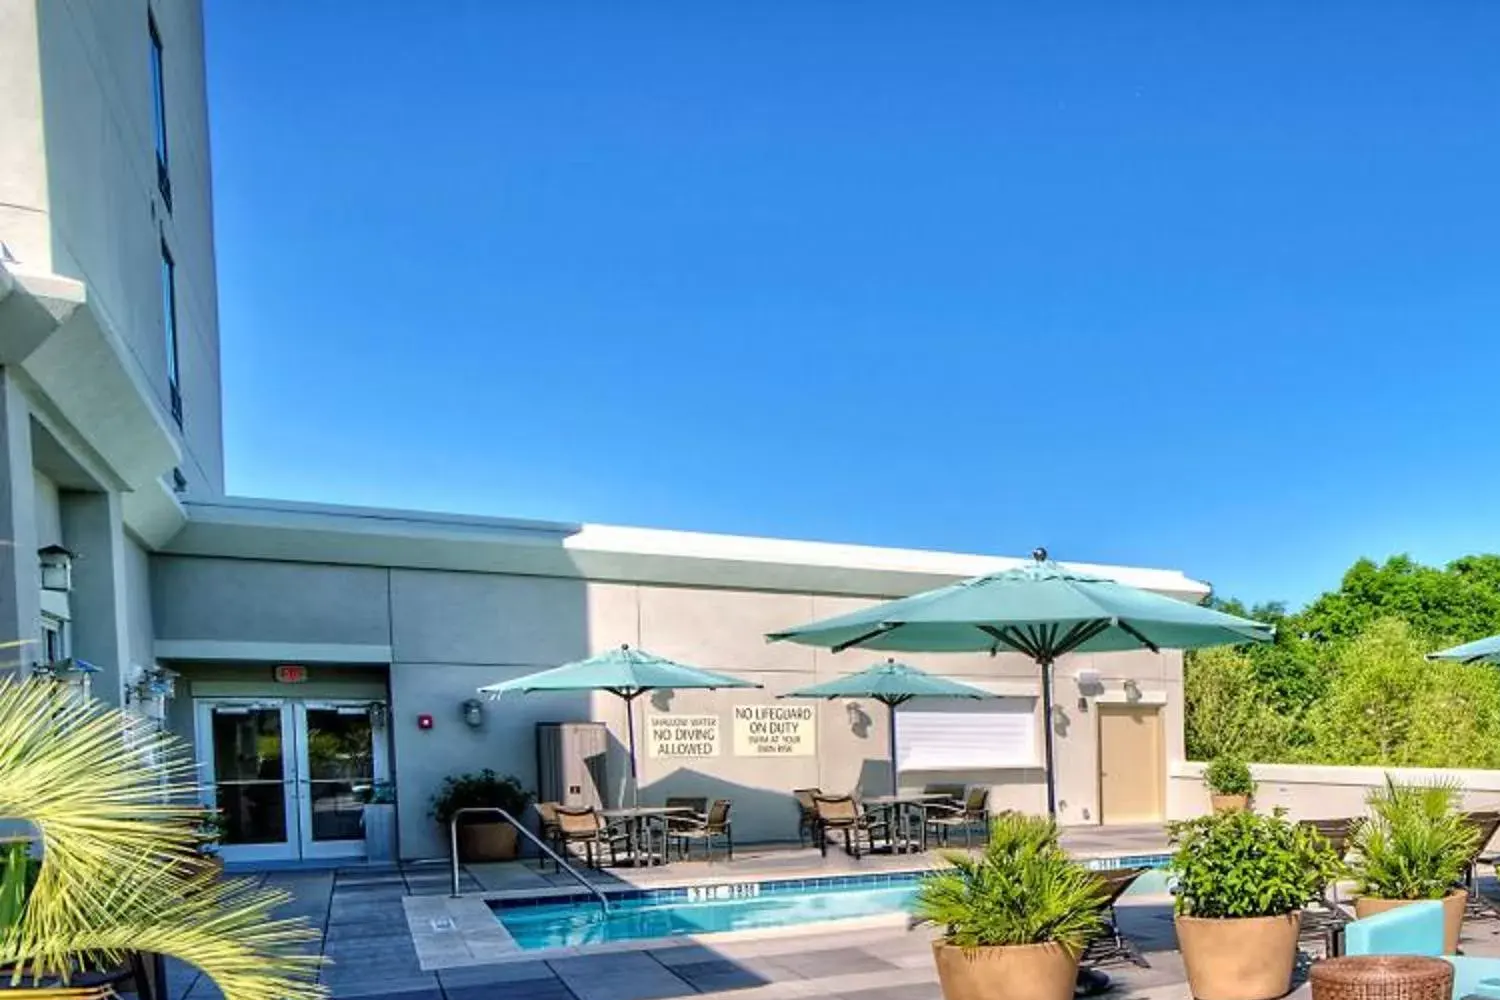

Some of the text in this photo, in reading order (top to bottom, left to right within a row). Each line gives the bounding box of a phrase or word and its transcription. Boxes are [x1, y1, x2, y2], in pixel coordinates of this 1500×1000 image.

[736, 707, 812, 720] NO LIFEGUARD
[690, 718, 717, 726] WATER
[749, 721, 799, 734] ON DUTY
[653, 728, 715, 740] NO DIVING
[657, 743, 713, 755] ALLOWED
